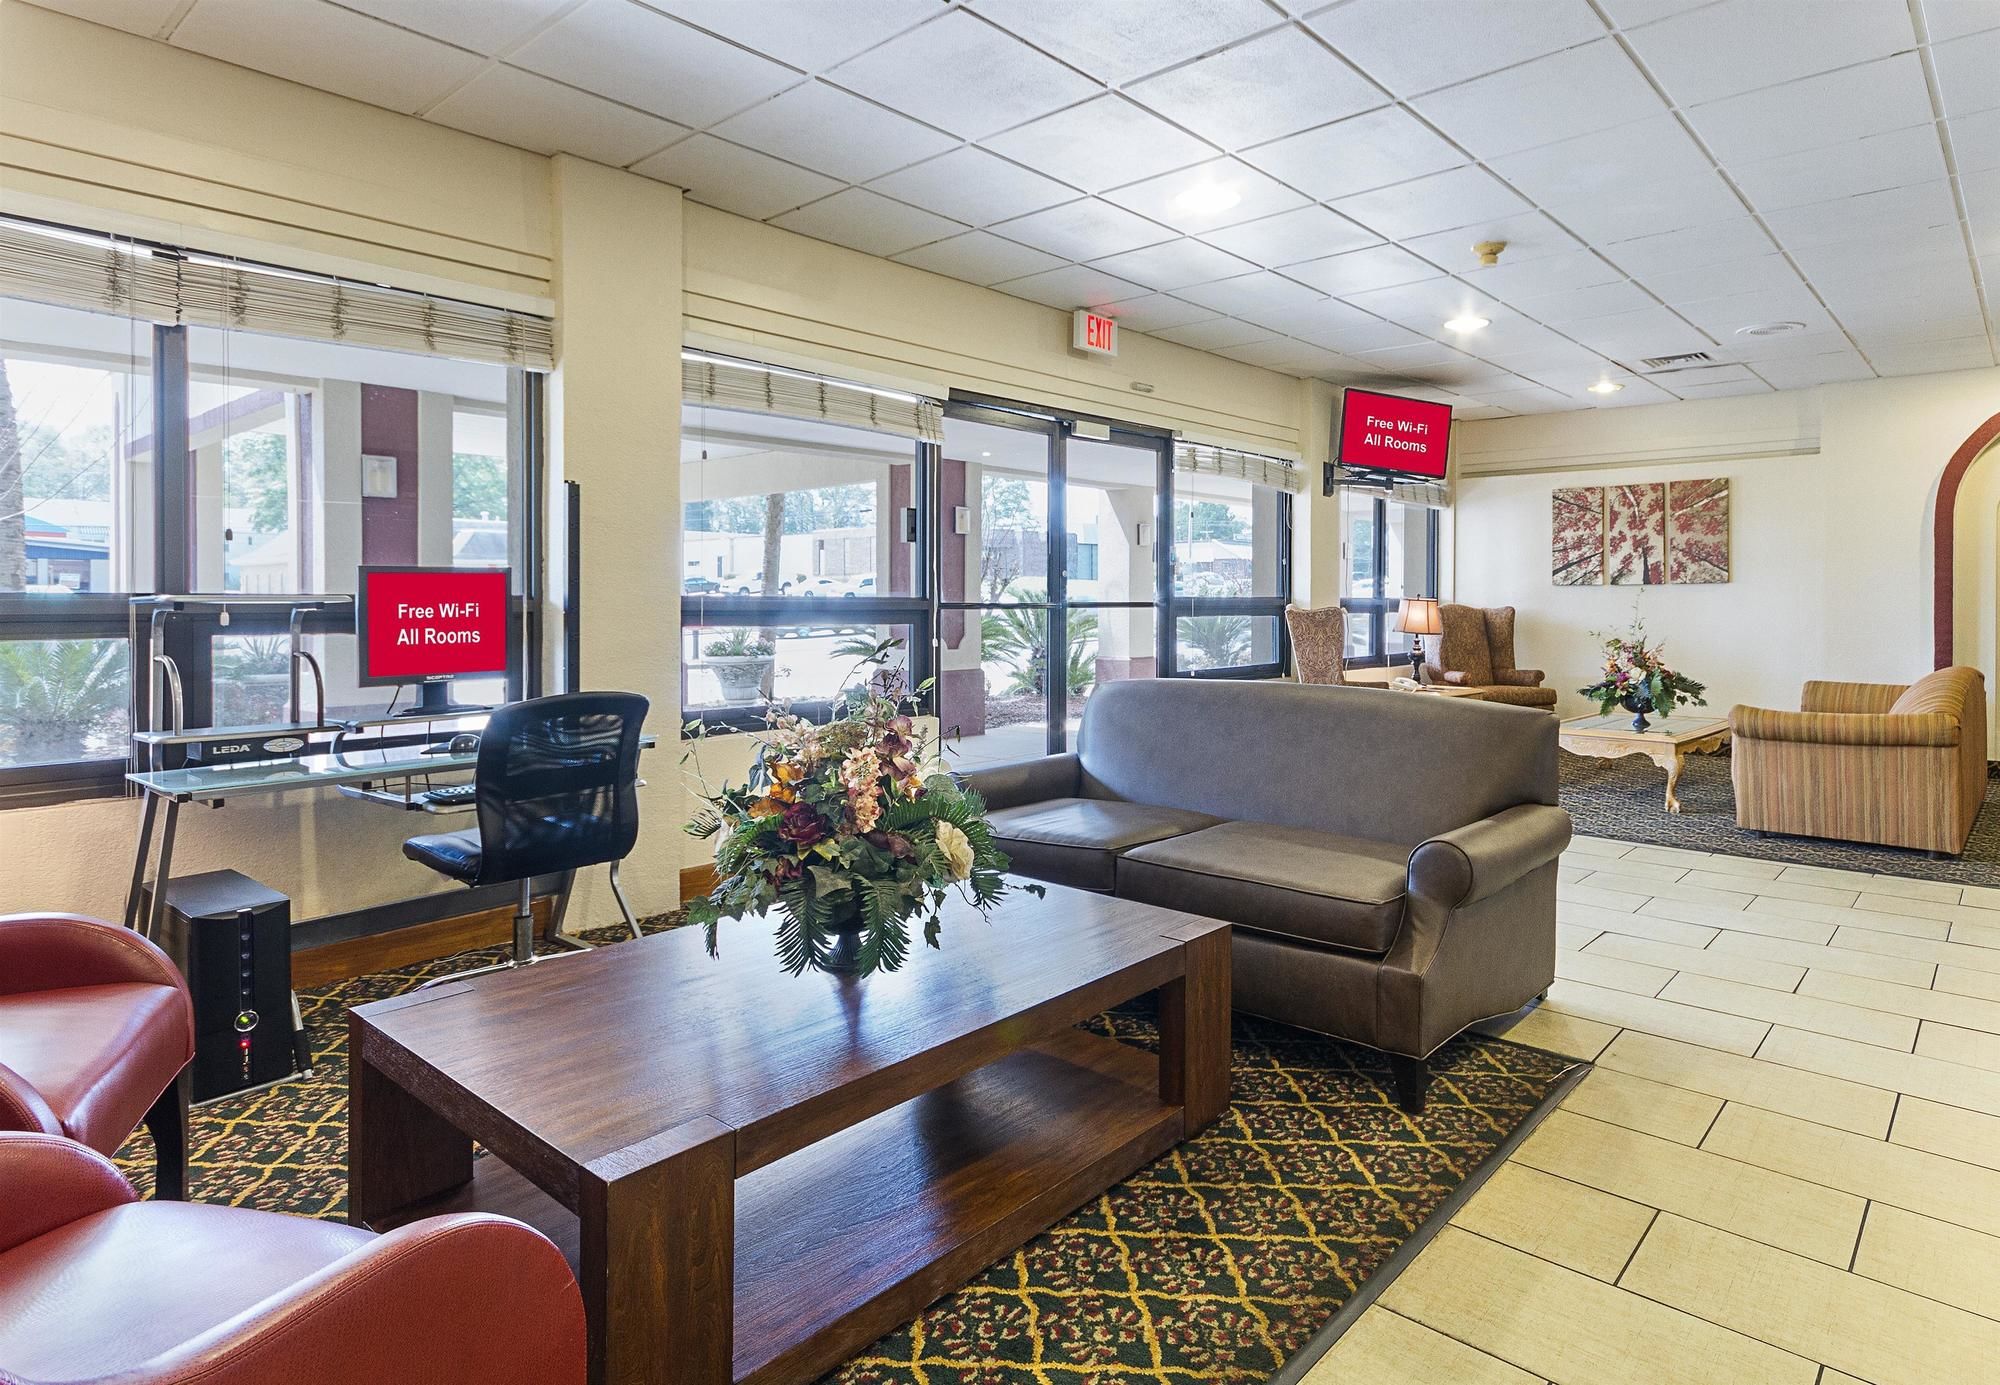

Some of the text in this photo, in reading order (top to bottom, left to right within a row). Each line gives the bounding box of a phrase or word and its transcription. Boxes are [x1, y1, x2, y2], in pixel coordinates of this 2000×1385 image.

[1087, 314, 1113, 351] EXIT
[1366, 415, 1428, 435] Free Wi-Fi
[1363, 433, 1427, 453] All Rooms
[397, 603, 480, 619] Free Wi-Fi
[396, 628, 481, 646] All Rooms
[212, 744, 251, 755] LEDA
